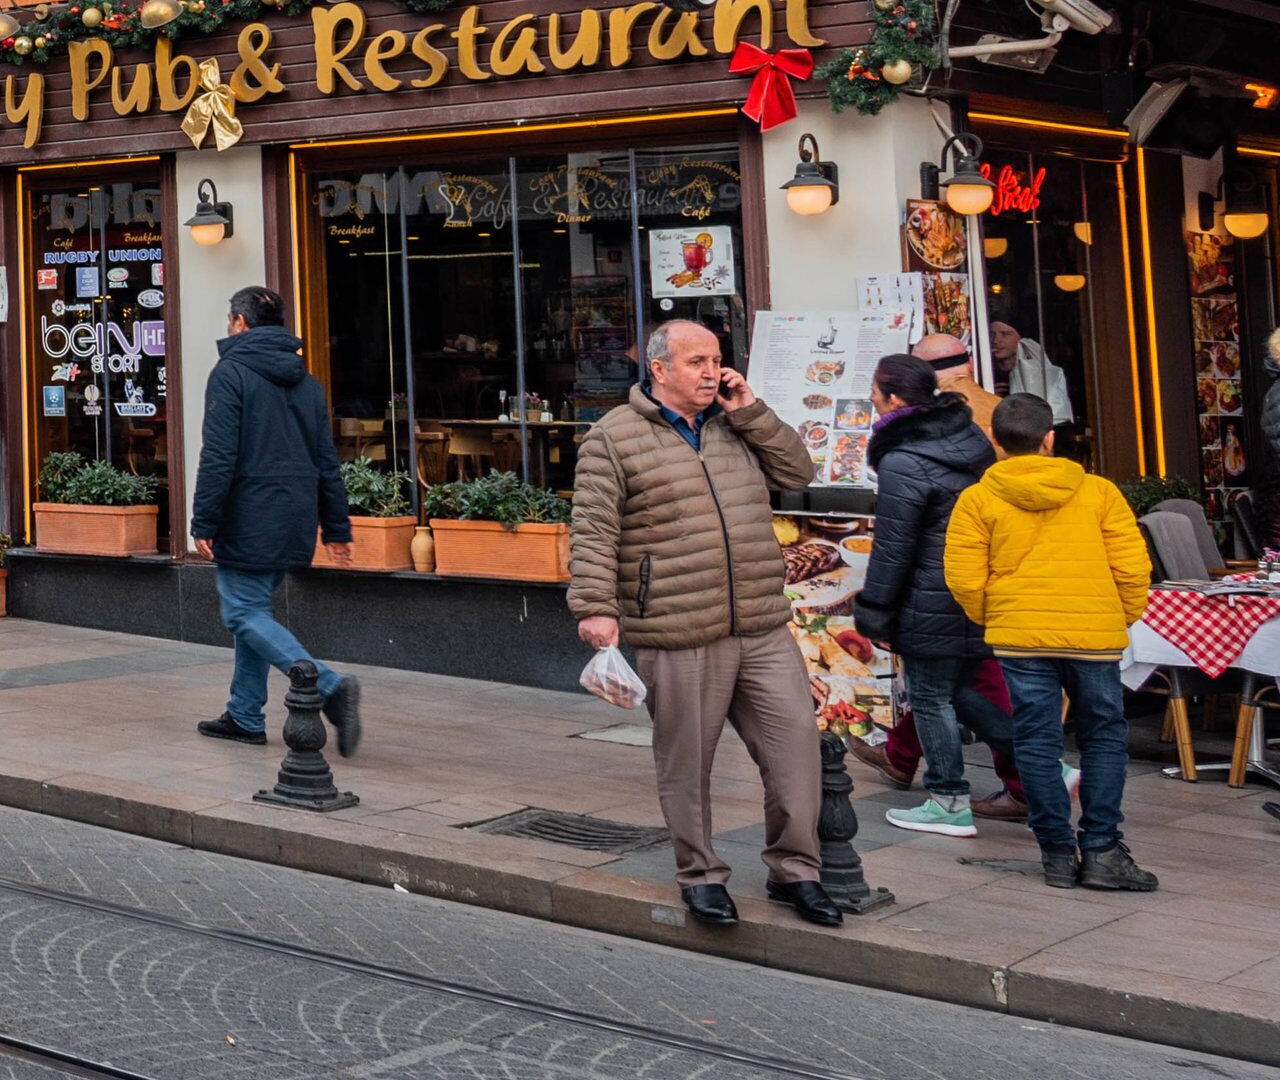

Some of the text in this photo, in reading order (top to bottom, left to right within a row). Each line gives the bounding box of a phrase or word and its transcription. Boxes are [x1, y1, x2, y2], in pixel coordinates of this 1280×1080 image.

[68, 37, 199, 121] Pub
[234, 22, 286, 103] &
[679, 156, 742, 181] Restaurant
[554, 211, 592, 224] Dinner
[681, 205, 712, 220] Café
[443, 216, 473, 228] Lunch
[329, 224, 376, 238] Breakfast
[53, 238, 74, 250] Café
[44, 248, 162, 264] RUGBY UNION
